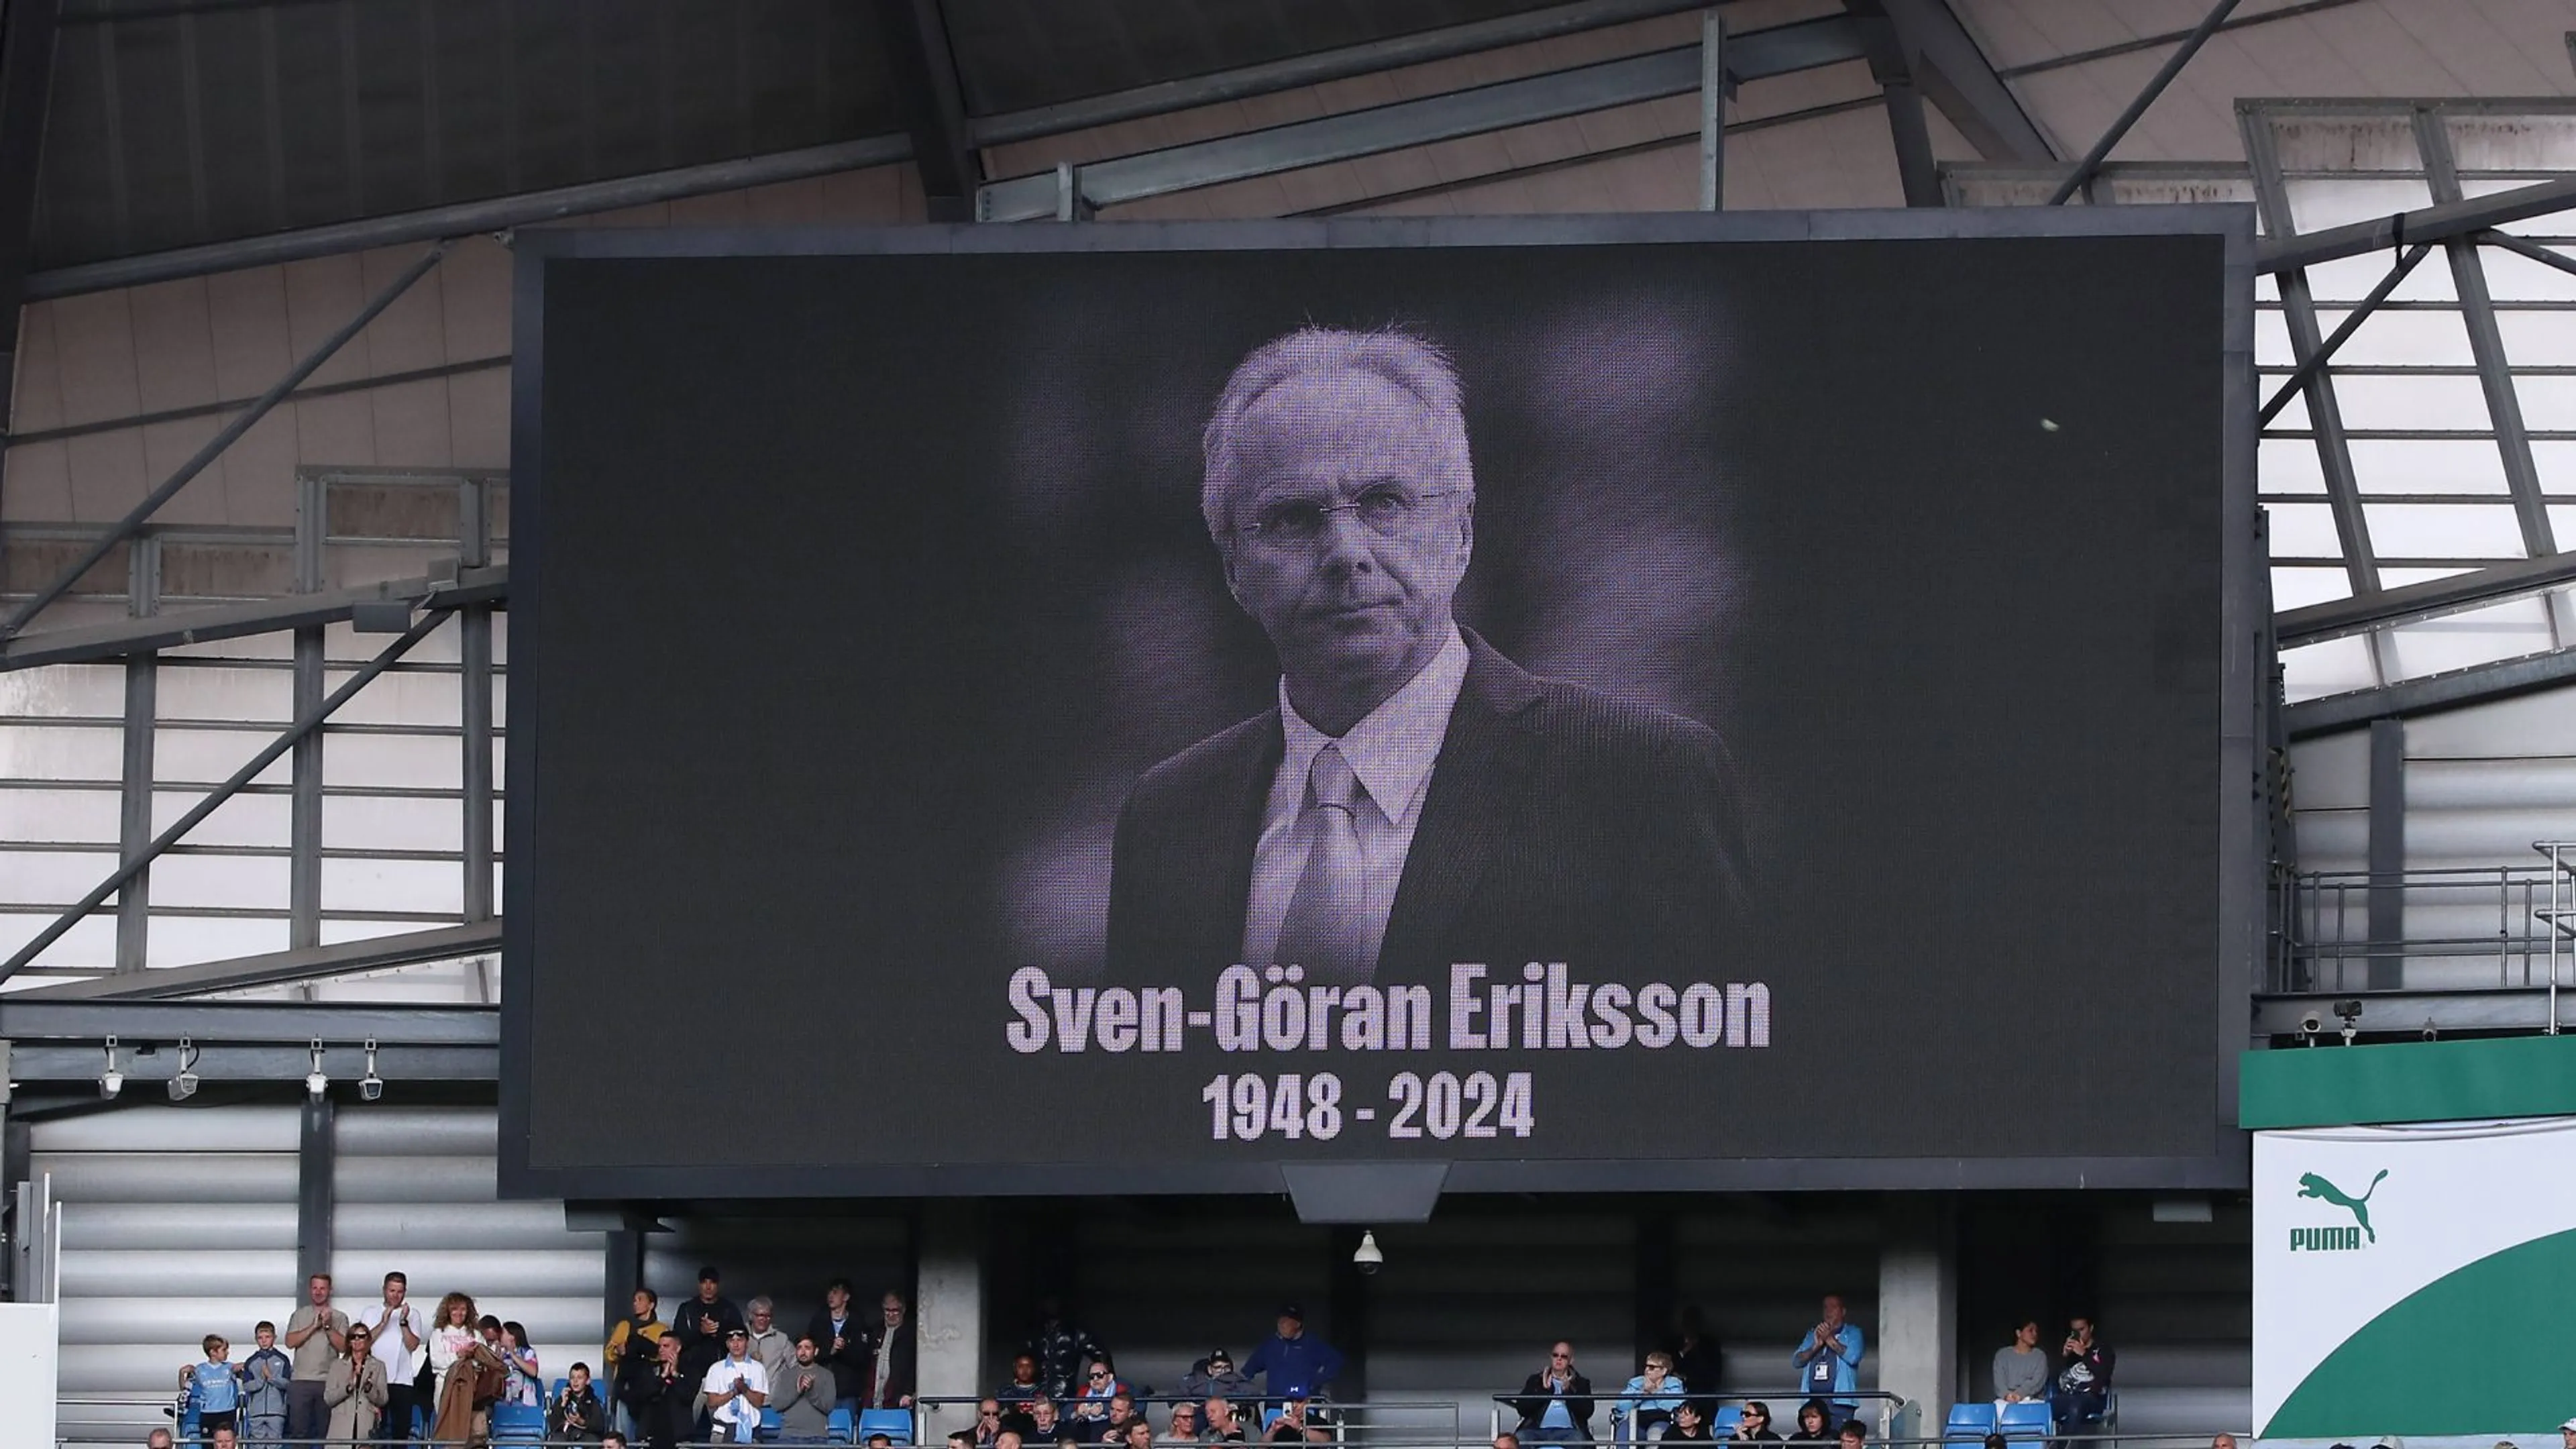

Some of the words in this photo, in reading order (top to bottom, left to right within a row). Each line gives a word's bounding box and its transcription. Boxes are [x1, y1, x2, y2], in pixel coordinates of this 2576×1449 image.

[1006, 964, 1432, 1053] Sven-Göran
[1449, 962, 1770, 1049] Eriksson
[1202, 1073, 1342, 1140] 1948
[1356, 1108, 1375, 1120] -
[1388, 1070, 1536, 1140] 2024
[2290, 1226, 2360, 1251] PUMA
